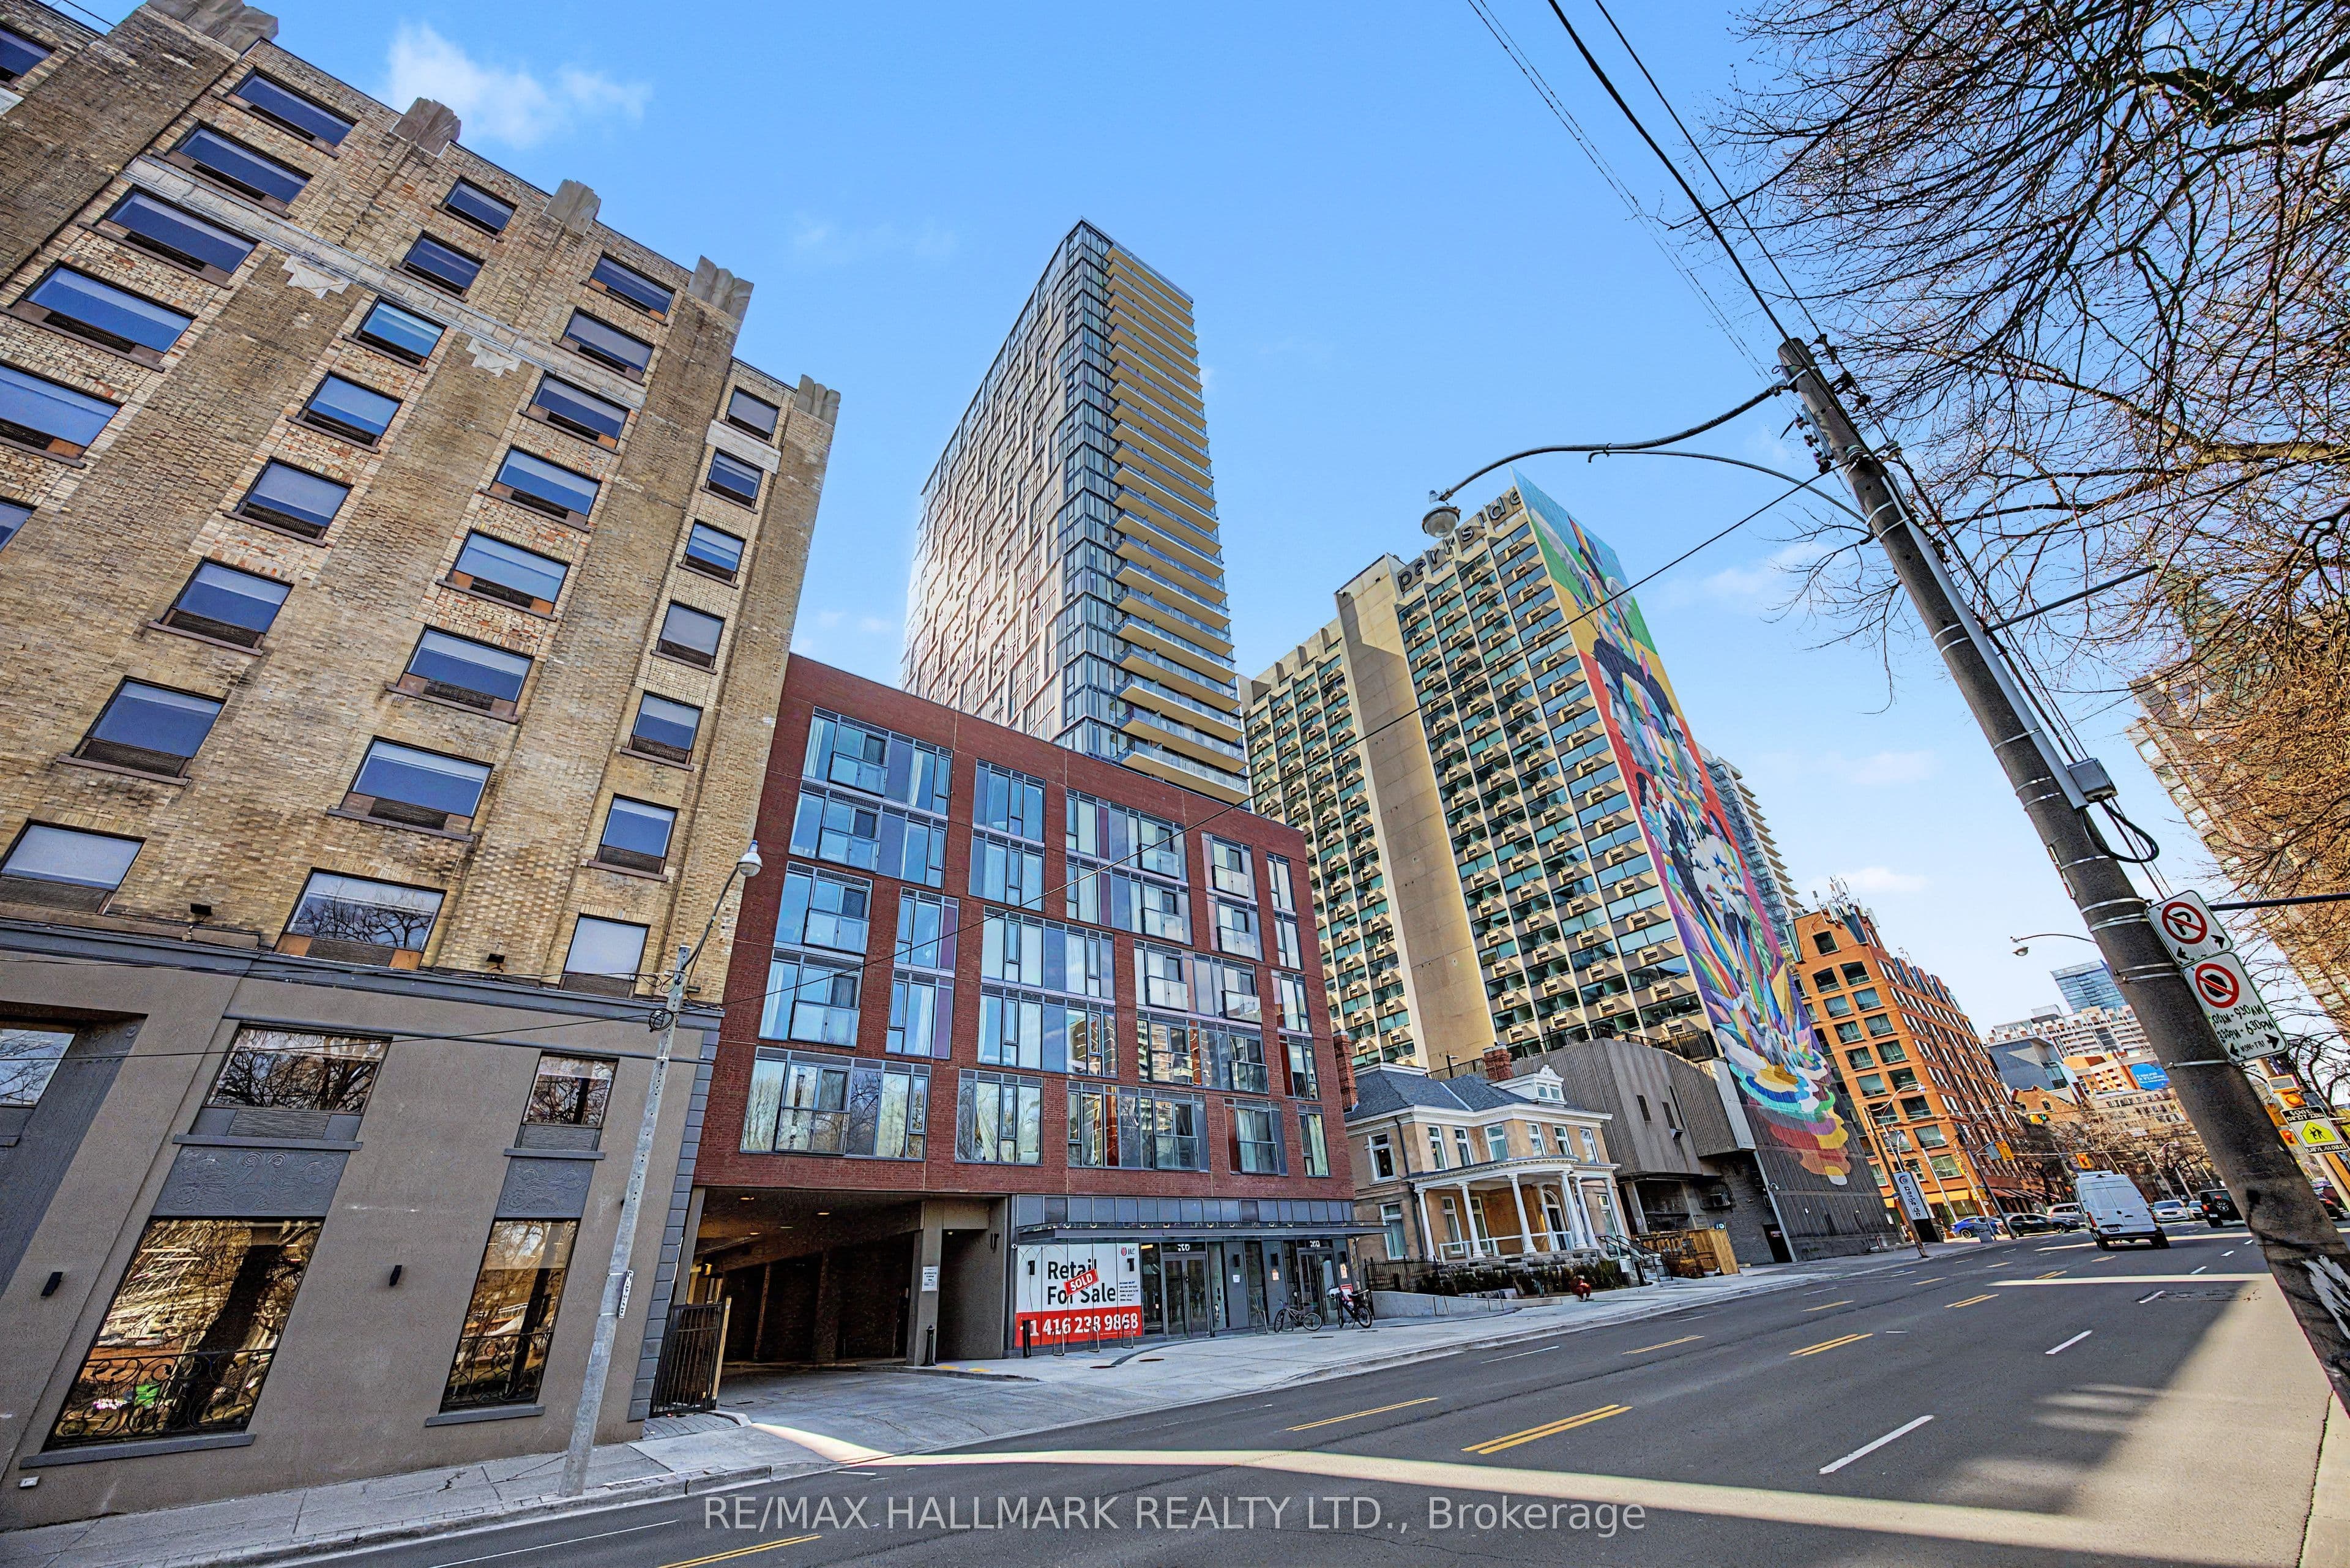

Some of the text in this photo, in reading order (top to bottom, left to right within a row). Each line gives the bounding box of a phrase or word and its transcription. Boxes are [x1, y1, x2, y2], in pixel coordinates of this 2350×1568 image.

[1047, 1258, 1097, 1280] Retail
[1070, 1272, 1094, 1292] SOLD
[1080, 1282, 1116, 1304] Sale
[1043, 1318, 1071, 1336] 416
[1074, 1315, 1101, 1334] 238
[1104, 1312, 1139, 1331] 9868
